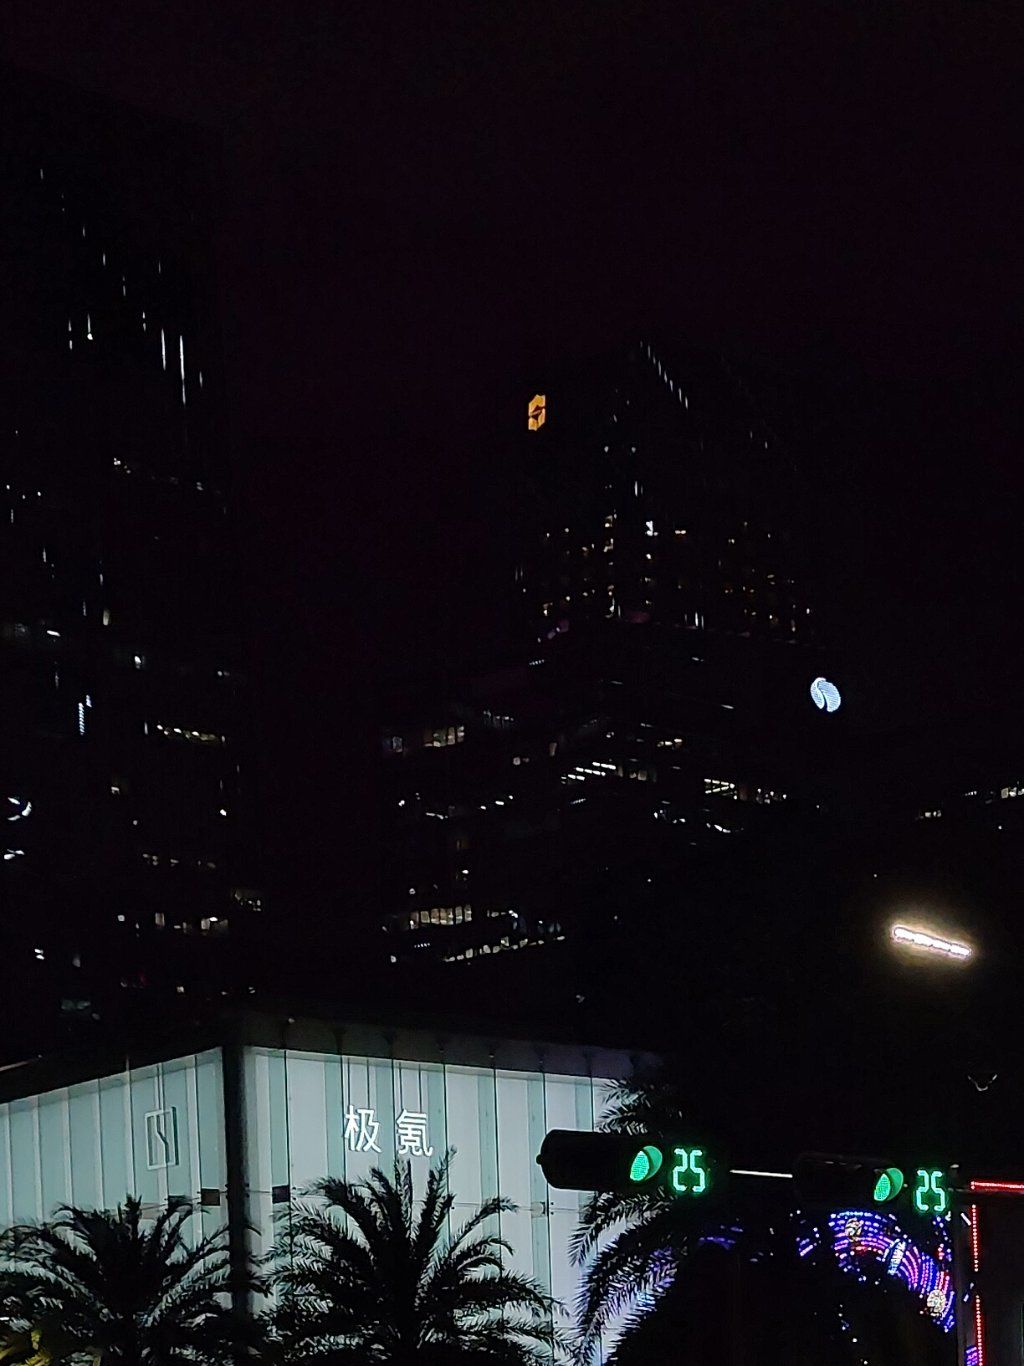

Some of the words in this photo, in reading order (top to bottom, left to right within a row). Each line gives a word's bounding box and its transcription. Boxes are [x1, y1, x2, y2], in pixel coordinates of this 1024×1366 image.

[344, 1104, 434, 1157] 极氪
[673, 1148, 706, 1193] 25
[916, 1169, 946, 1212] 25
